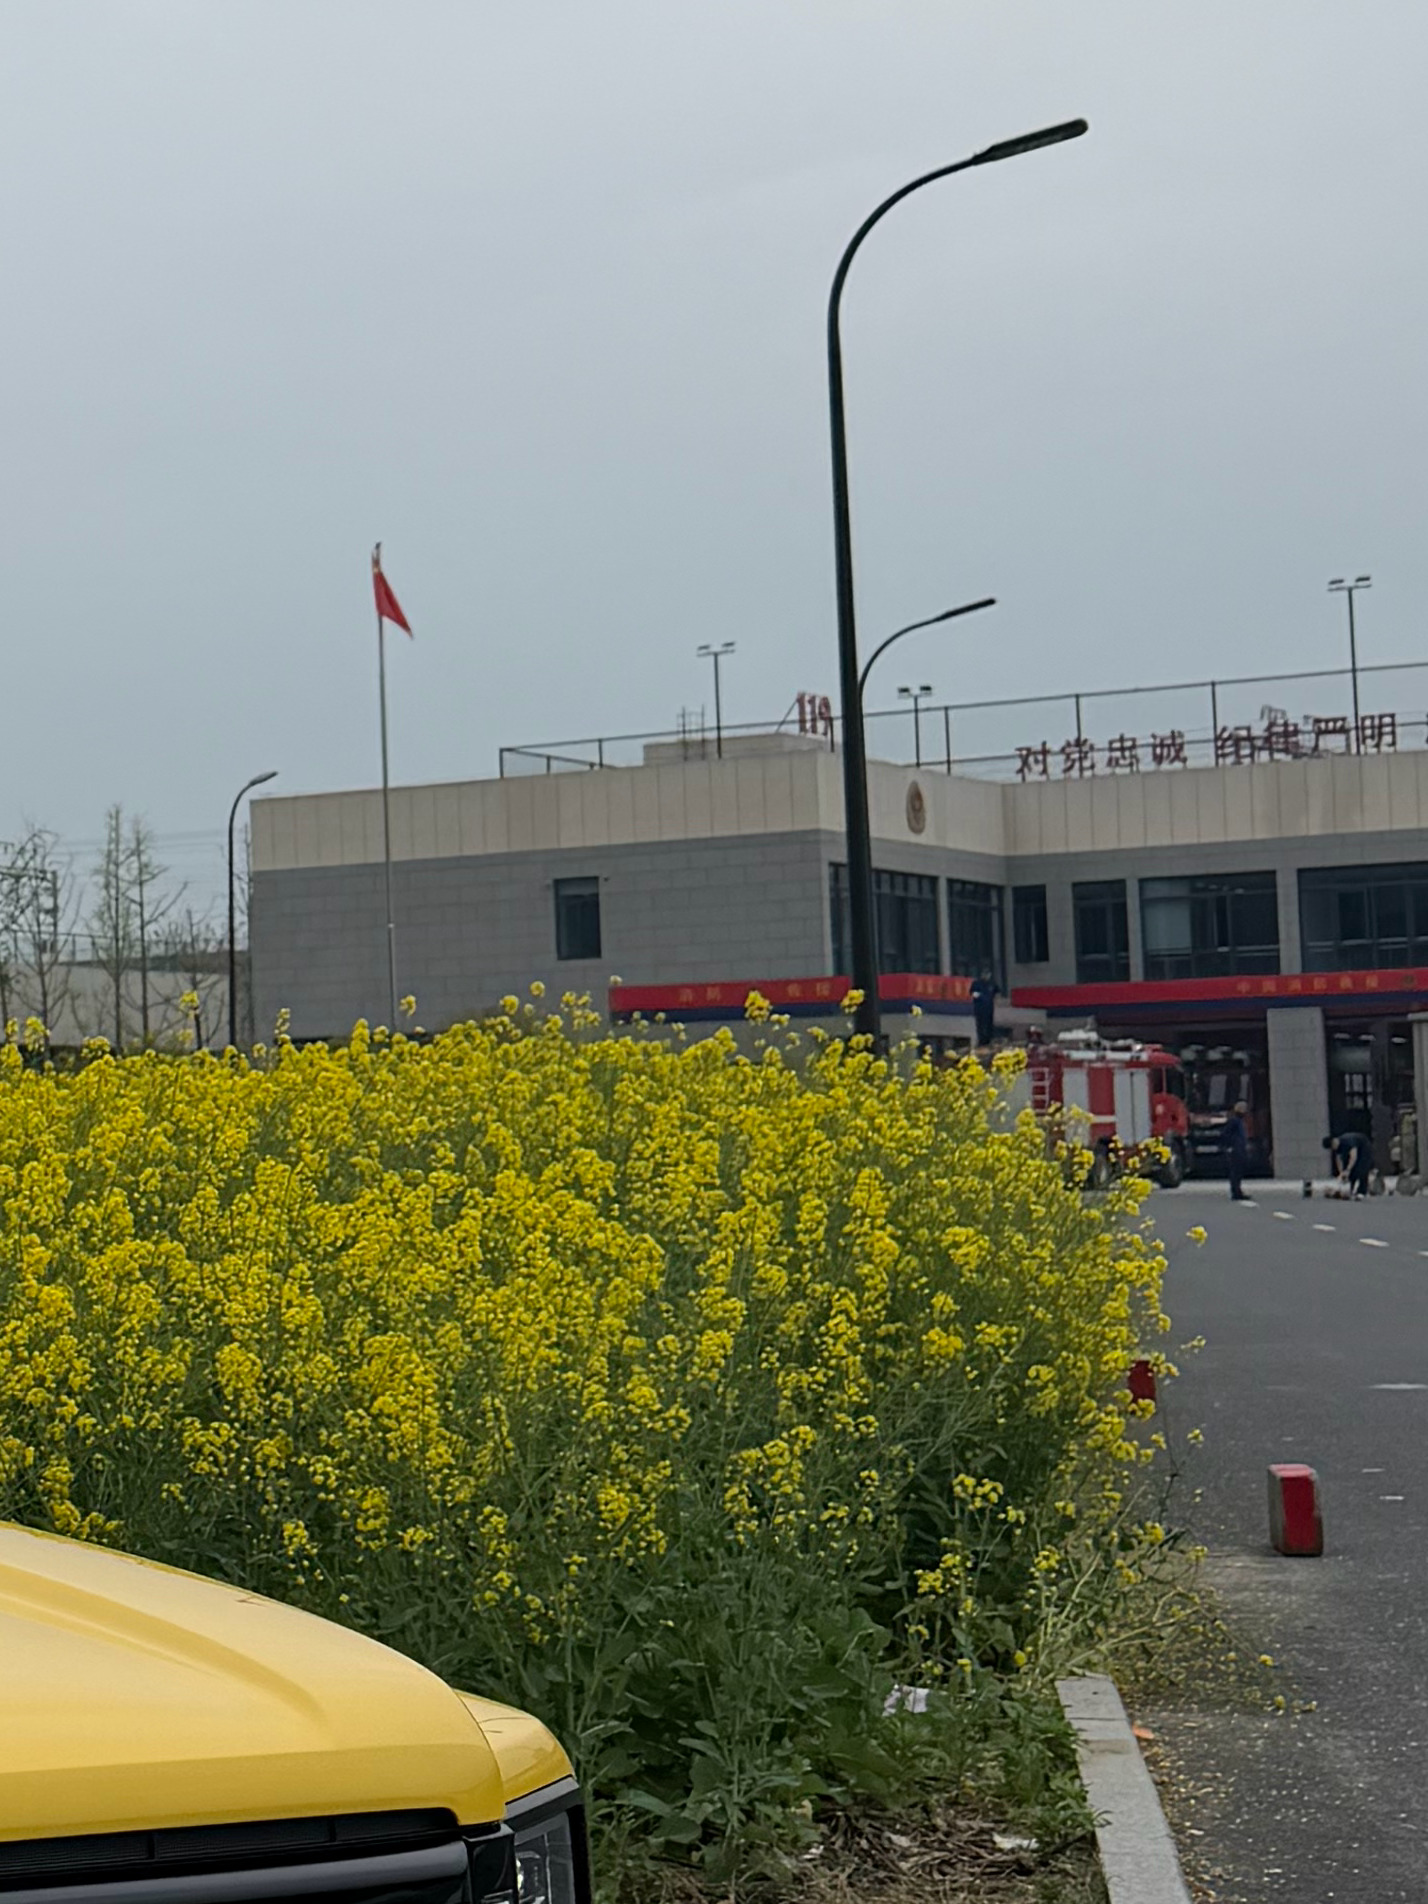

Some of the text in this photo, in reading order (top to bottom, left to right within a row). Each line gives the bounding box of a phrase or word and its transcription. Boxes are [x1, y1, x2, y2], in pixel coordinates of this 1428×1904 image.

[796, 691, 831, 735] 119
[1015, 729, 1188, 777] 对党忠诚
